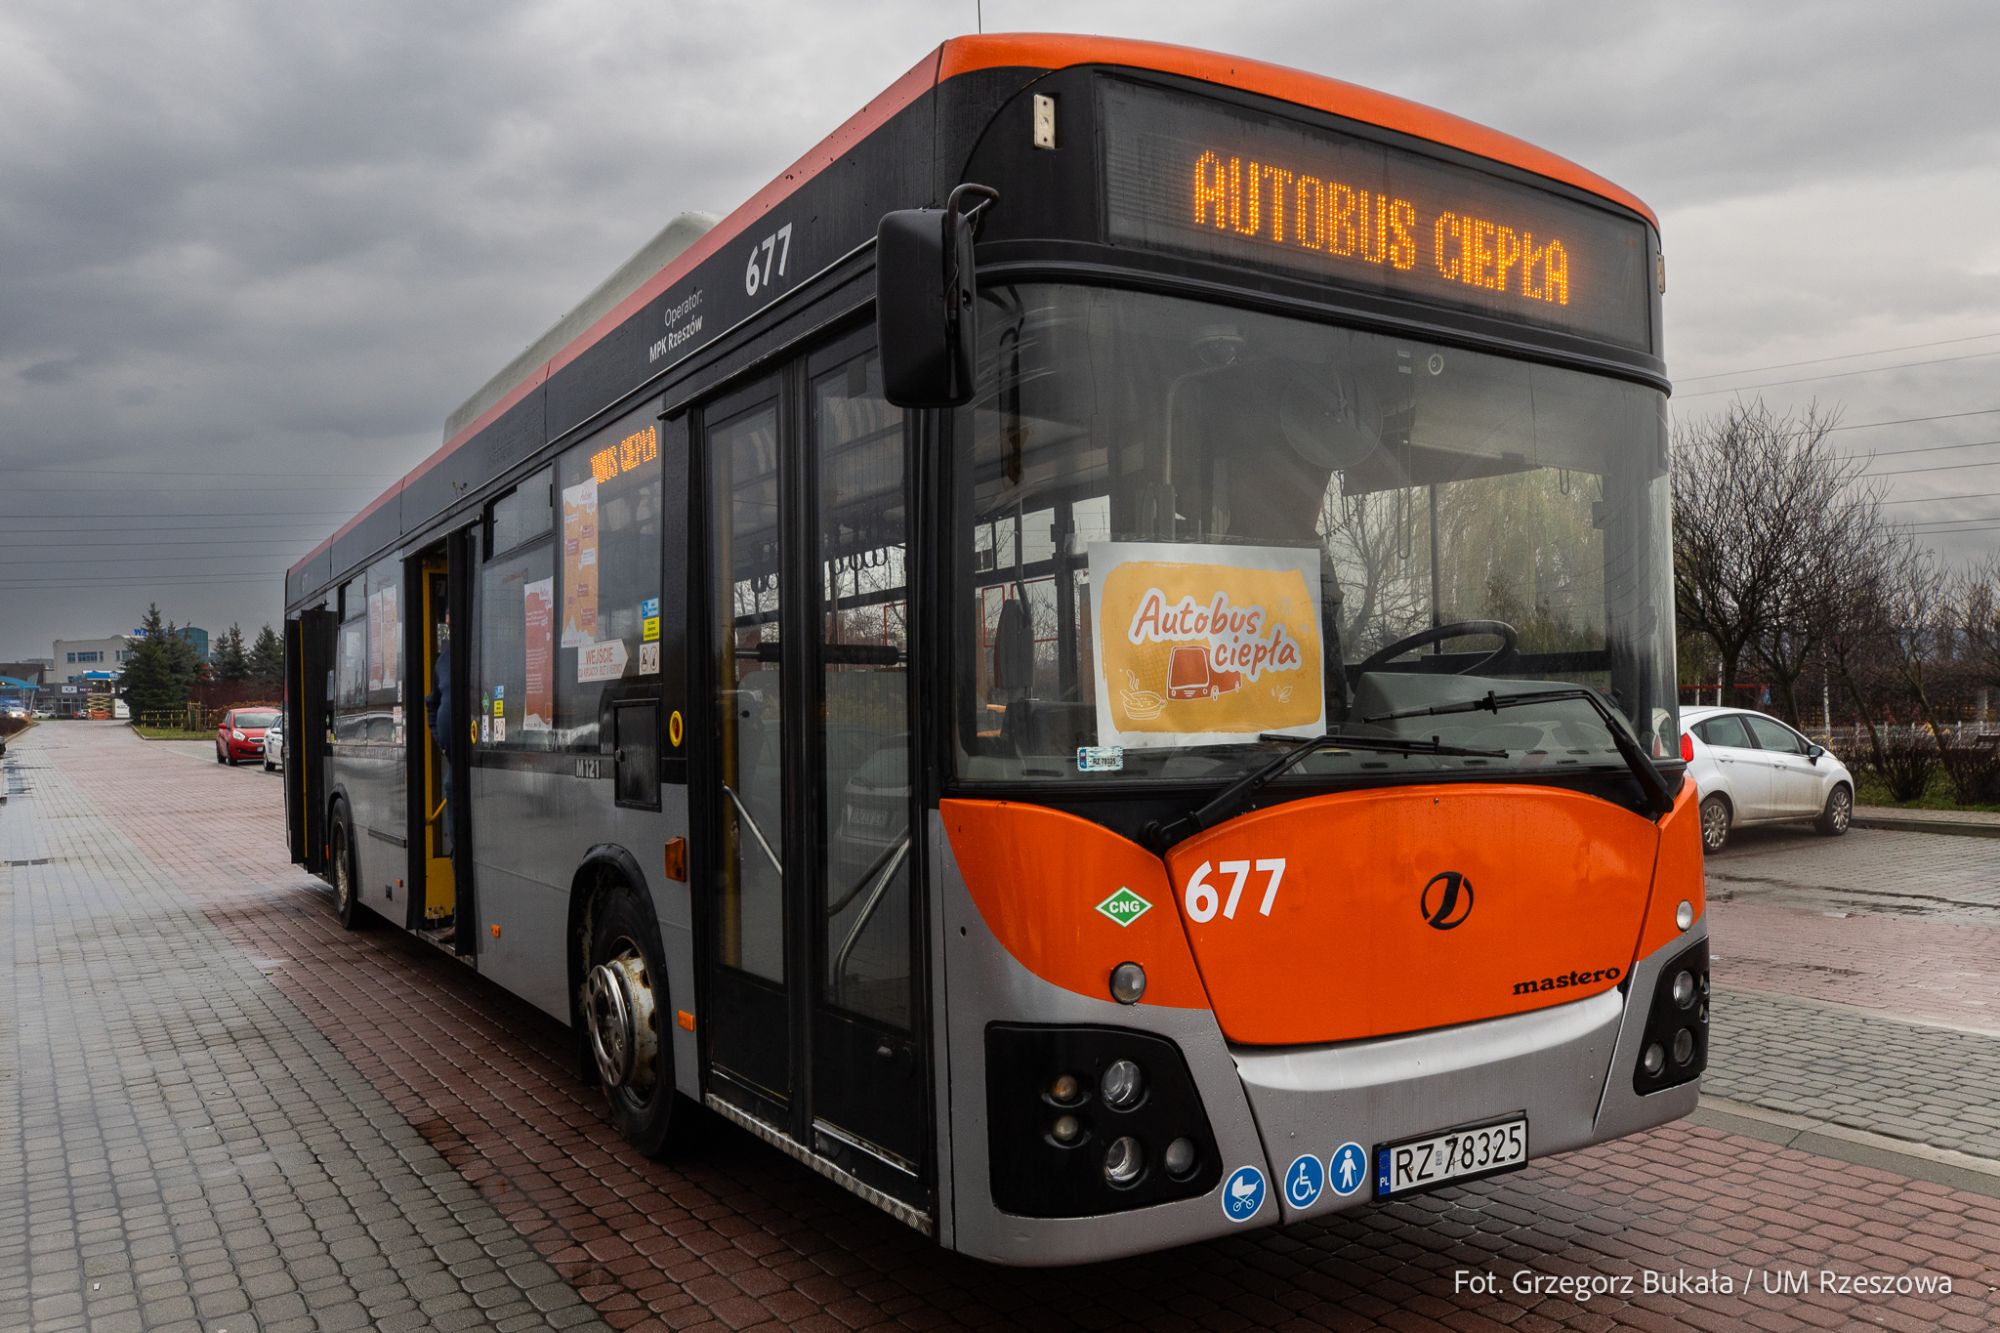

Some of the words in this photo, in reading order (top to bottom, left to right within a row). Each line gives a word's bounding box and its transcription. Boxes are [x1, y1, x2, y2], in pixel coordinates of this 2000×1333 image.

[1194, 150, 1416, 270] AUTOBUS
[1434, 210, 1569, 306] CIEPŁA
[746, 222, 792, 296] 677
[649, 336, 667, 363] MPK
[668, 314, 703, 350] Rzeszów
[1134, 593, 1261, 637] Autobus
[1214, 629, 1297, 676] ciepła
[1109, 900, 1140, 914] CNG
[1185, 858, 1286, 923] 677
[1512, 967, 1621, 995] mastero
[1396, 1143, 1434, 1186] RZ
[1444, 1125, 1522, 1175] 78325
[1379, 1177, 1390, 1188] PL
